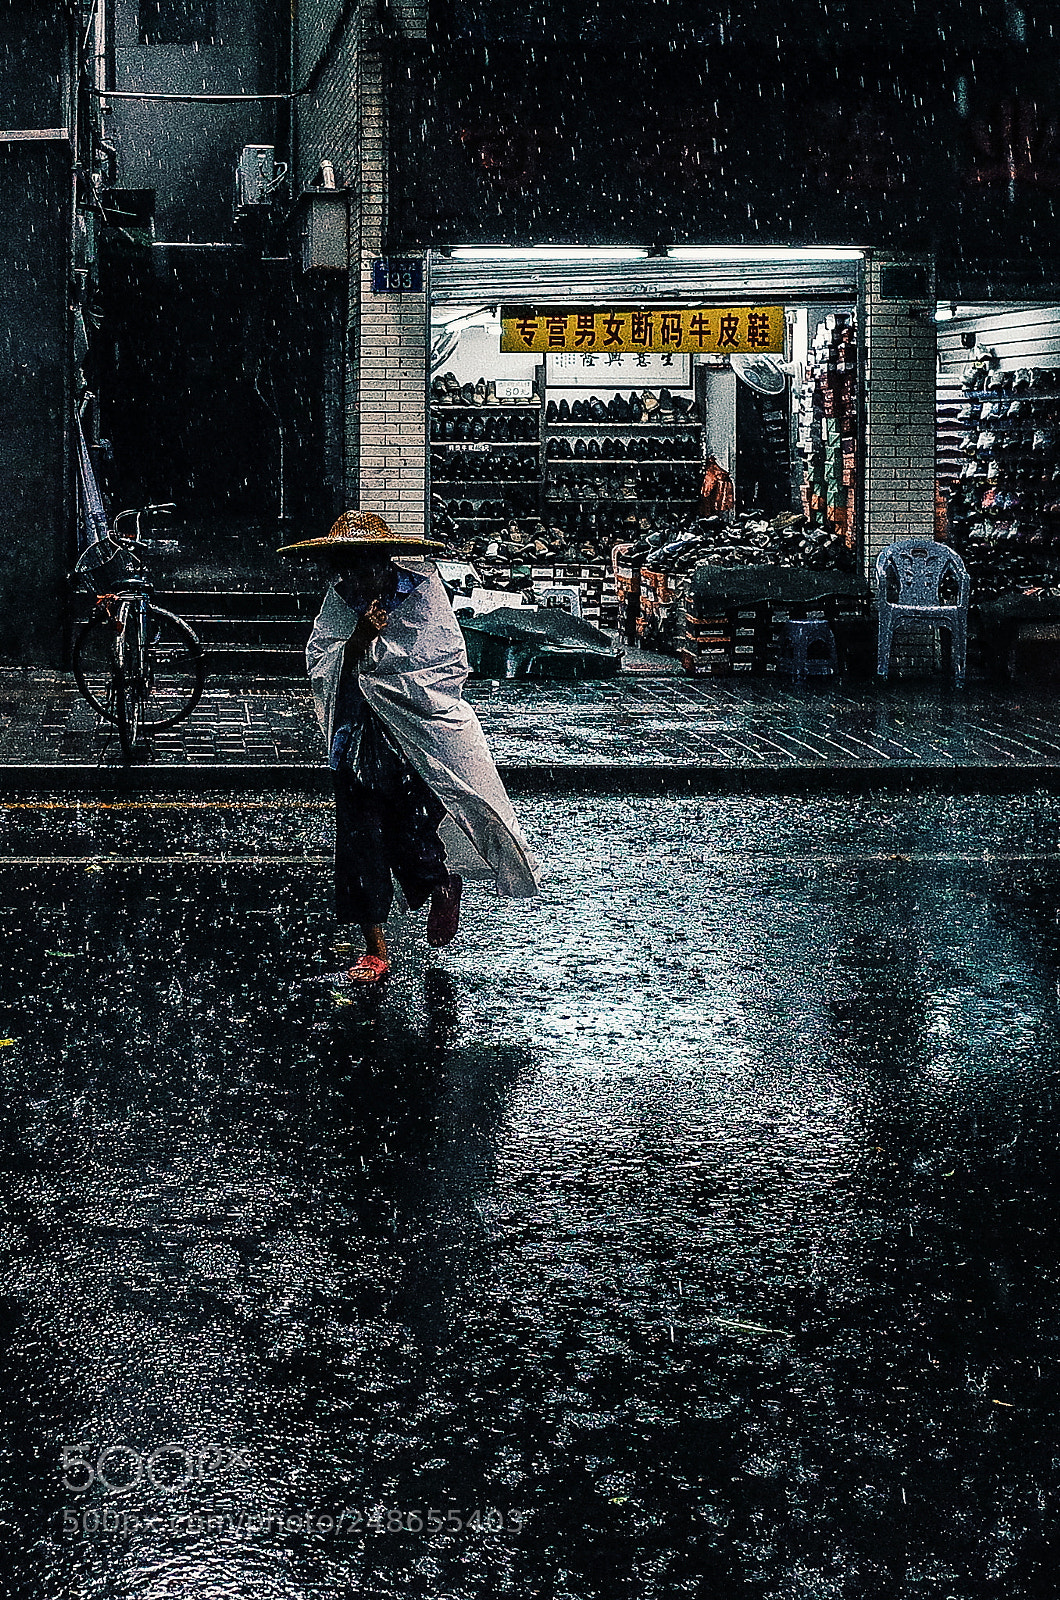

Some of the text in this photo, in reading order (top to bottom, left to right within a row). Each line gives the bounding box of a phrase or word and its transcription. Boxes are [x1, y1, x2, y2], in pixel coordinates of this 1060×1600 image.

[383, 272, 411, 289] 133
[515, 312, 771, 348] 专营男女断码牛皮鞋
